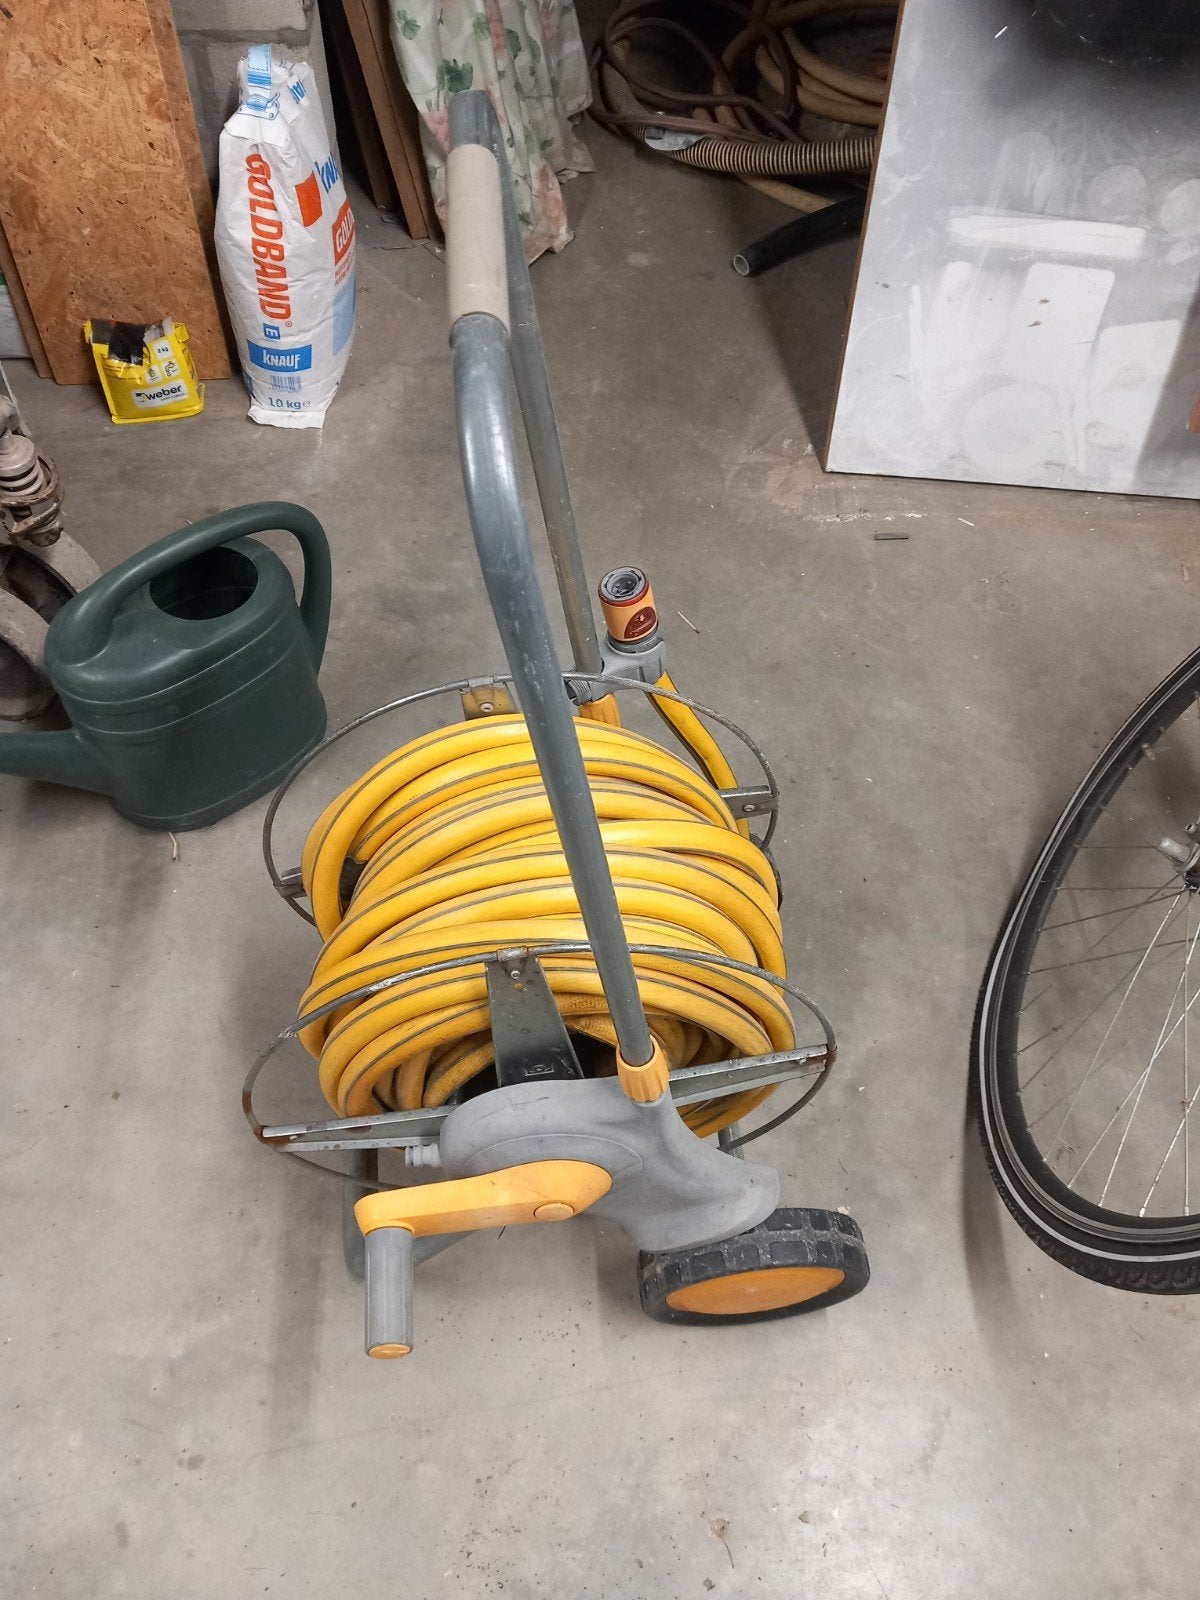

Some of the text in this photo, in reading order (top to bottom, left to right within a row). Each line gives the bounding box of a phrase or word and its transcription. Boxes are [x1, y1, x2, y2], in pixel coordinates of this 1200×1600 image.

[262, 349, 301, 370] KNAUF
[144, 384, 182, 401] weber
[268, 397, 284, 408] 10
